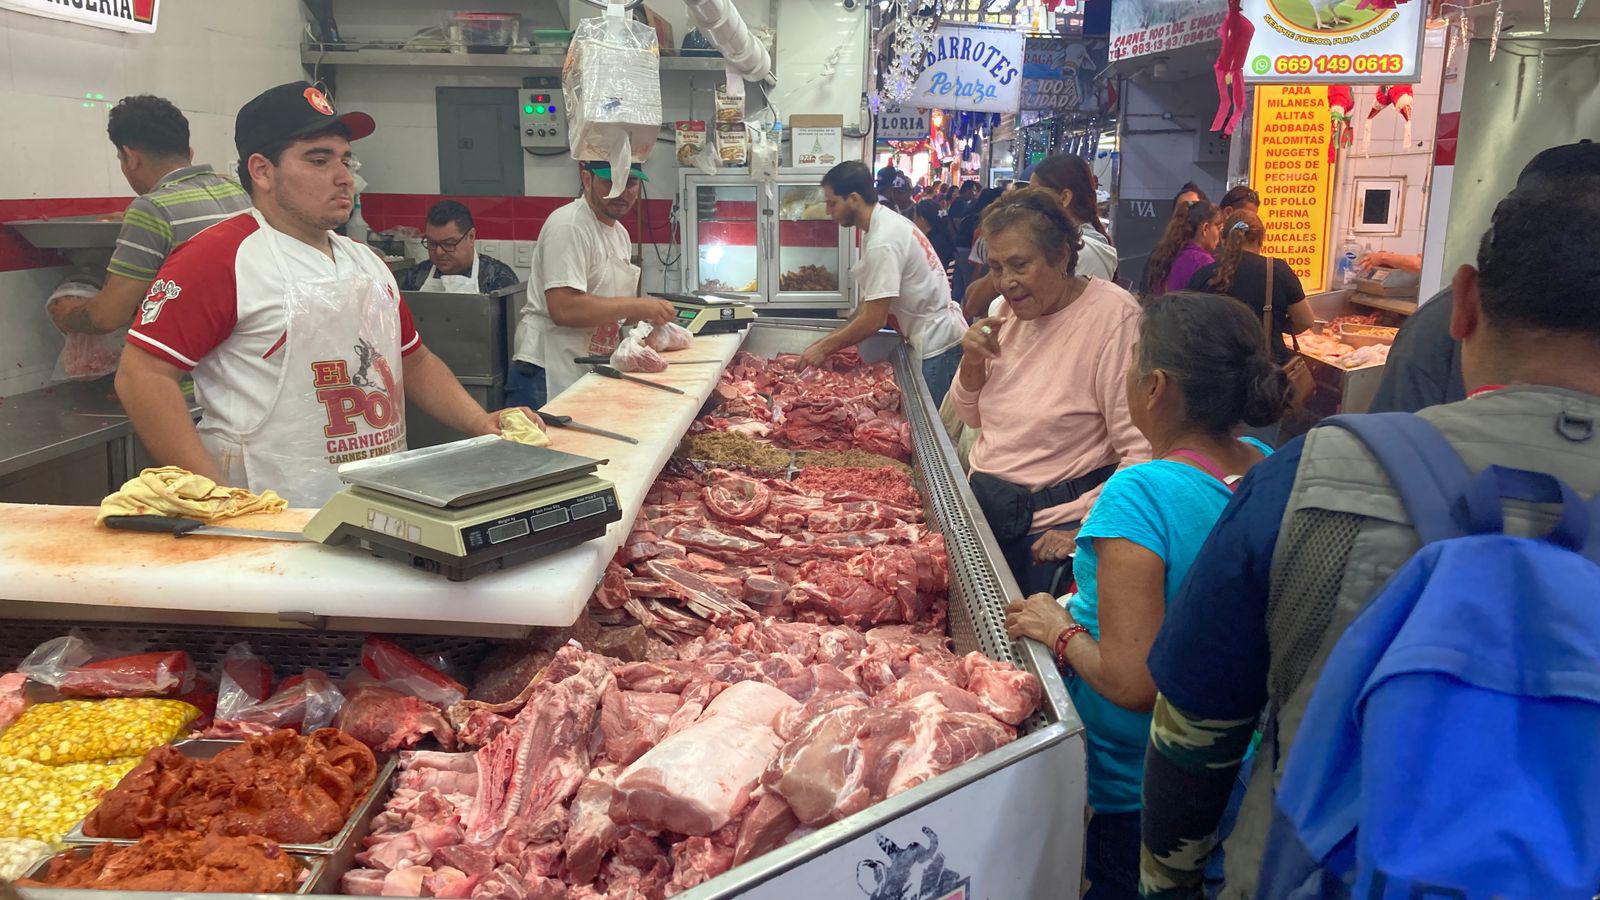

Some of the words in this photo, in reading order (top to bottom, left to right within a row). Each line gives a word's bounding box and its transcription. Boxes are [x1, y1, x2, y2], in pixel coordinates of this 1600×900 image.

[1264, 14, 1295, 40] SIEMPRE
[1333, 35, 1360, 45] PURA
[1360, 12, 1399, 40] CALIDAD
[1114, 31, 1146, 48] CARNE
[920, 35, 1019, 86] BARROTES
[1276, 56, 1312, 73] 669
[1315, 55, 1351, 73] 149
[1354, 54, 1403, 73] 0613
[929, 71, 998, 103] Peraza
[1281, 86, 1311, 95] PARA
[1267, 98, 1325, 108] MILANESA
[1275, 111, 1314, 120] ALITAS
[881, 116, 925, 130] LORIA
[1264, 123, 1325, 133] ADOBADAS
[1262, 136, 1325, 145] PALOMITAS
[1266, 148, 1319, 157] NUGGETS
[1264, 160, 1301, 169] DEDOS
[1305, 160, 1319, 169] DE
[1264, 173, 1318, 182] PECHUGA
[1265, 185, 1316, 194] CHORIZO
[1263, 197, 1278, 206] DE
[1280, 197, 1317, 206] POLLO
[1268, 209, 1309, 218] PIERNA
[1265, 221, 1311, 230] MUSLOS
[1264, 233, 1317, 242] UACALES
[1260, 245, 1316, 254] MOLLEJAS
[326, 427, 401, 454] CARNICERIA
